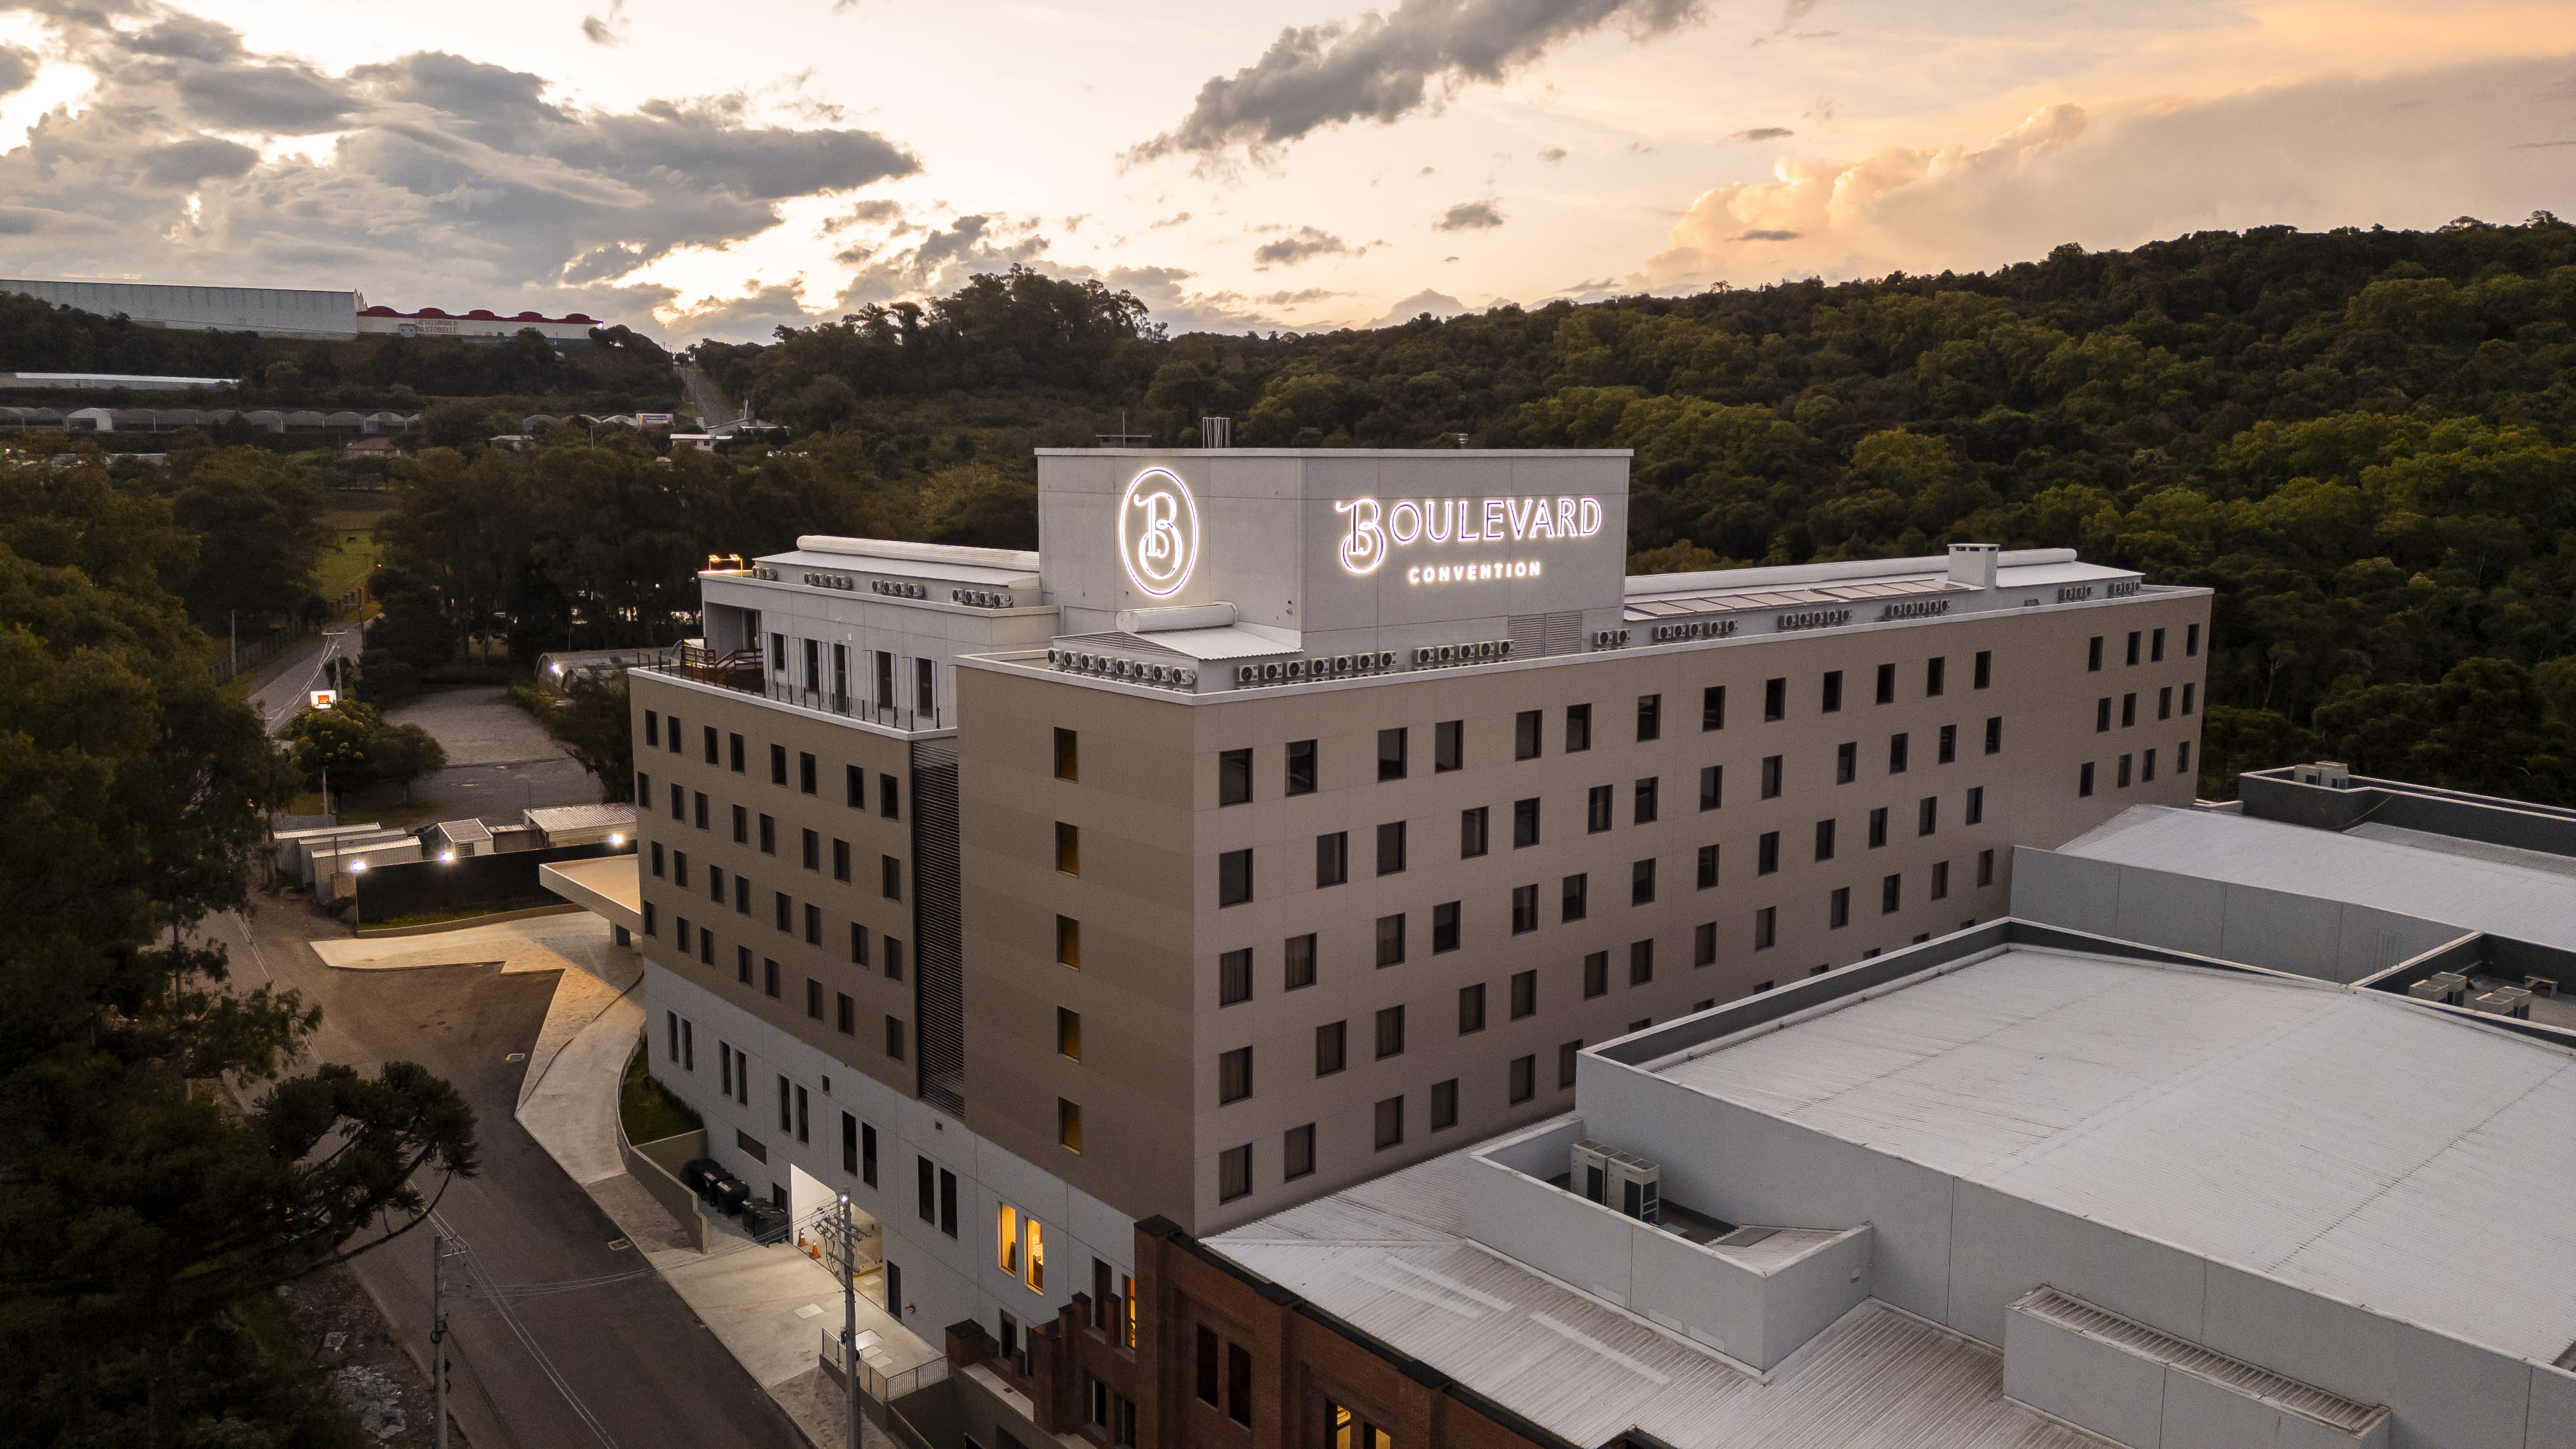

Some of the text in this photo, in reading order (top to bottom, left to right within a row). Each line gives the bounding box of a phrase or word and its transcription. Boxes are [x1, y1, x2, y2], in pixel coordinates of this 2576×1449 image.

[1133, 491, 1183, 579] B
[1335, 497, 1602, 574] BOULEVARD
[1409, 561, 1541, 584] CONVENTION
